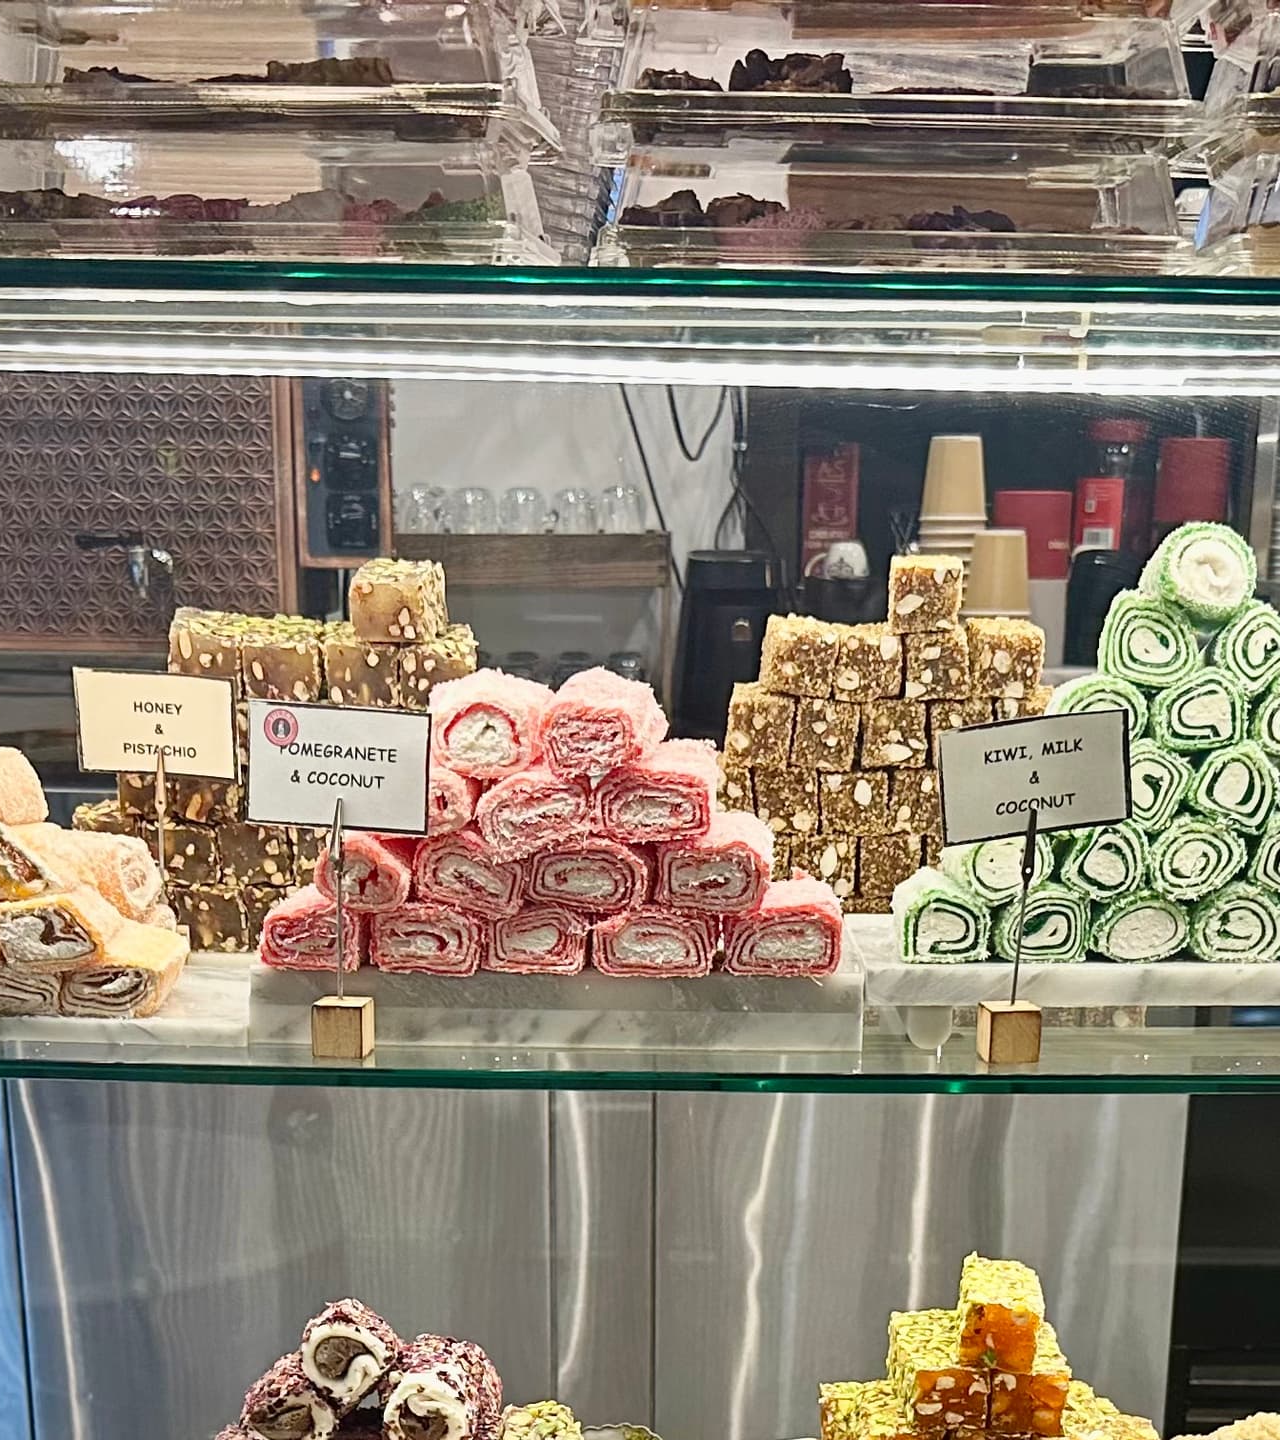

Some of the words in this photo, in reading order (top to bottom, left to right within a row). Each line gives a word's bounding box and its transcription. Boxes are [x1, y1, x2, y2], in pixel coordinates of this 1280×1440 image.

[133, 701, 183, 715] HONEY
[154, 723, 164, 735] &
[123, 742, 198, 759] PISTACHIO
[279, 742, 398, 763] POMEGRANETE
[983, 746, 1033, 764] KIWI,
[1041, 738, 1083, 757] MILK
[290, 769, 301, 784] &
[307, 771, 385, 789] COCONUT
[1029, 770, 1040, 785] &
[995, 793, 1076, 816] COCONUT
